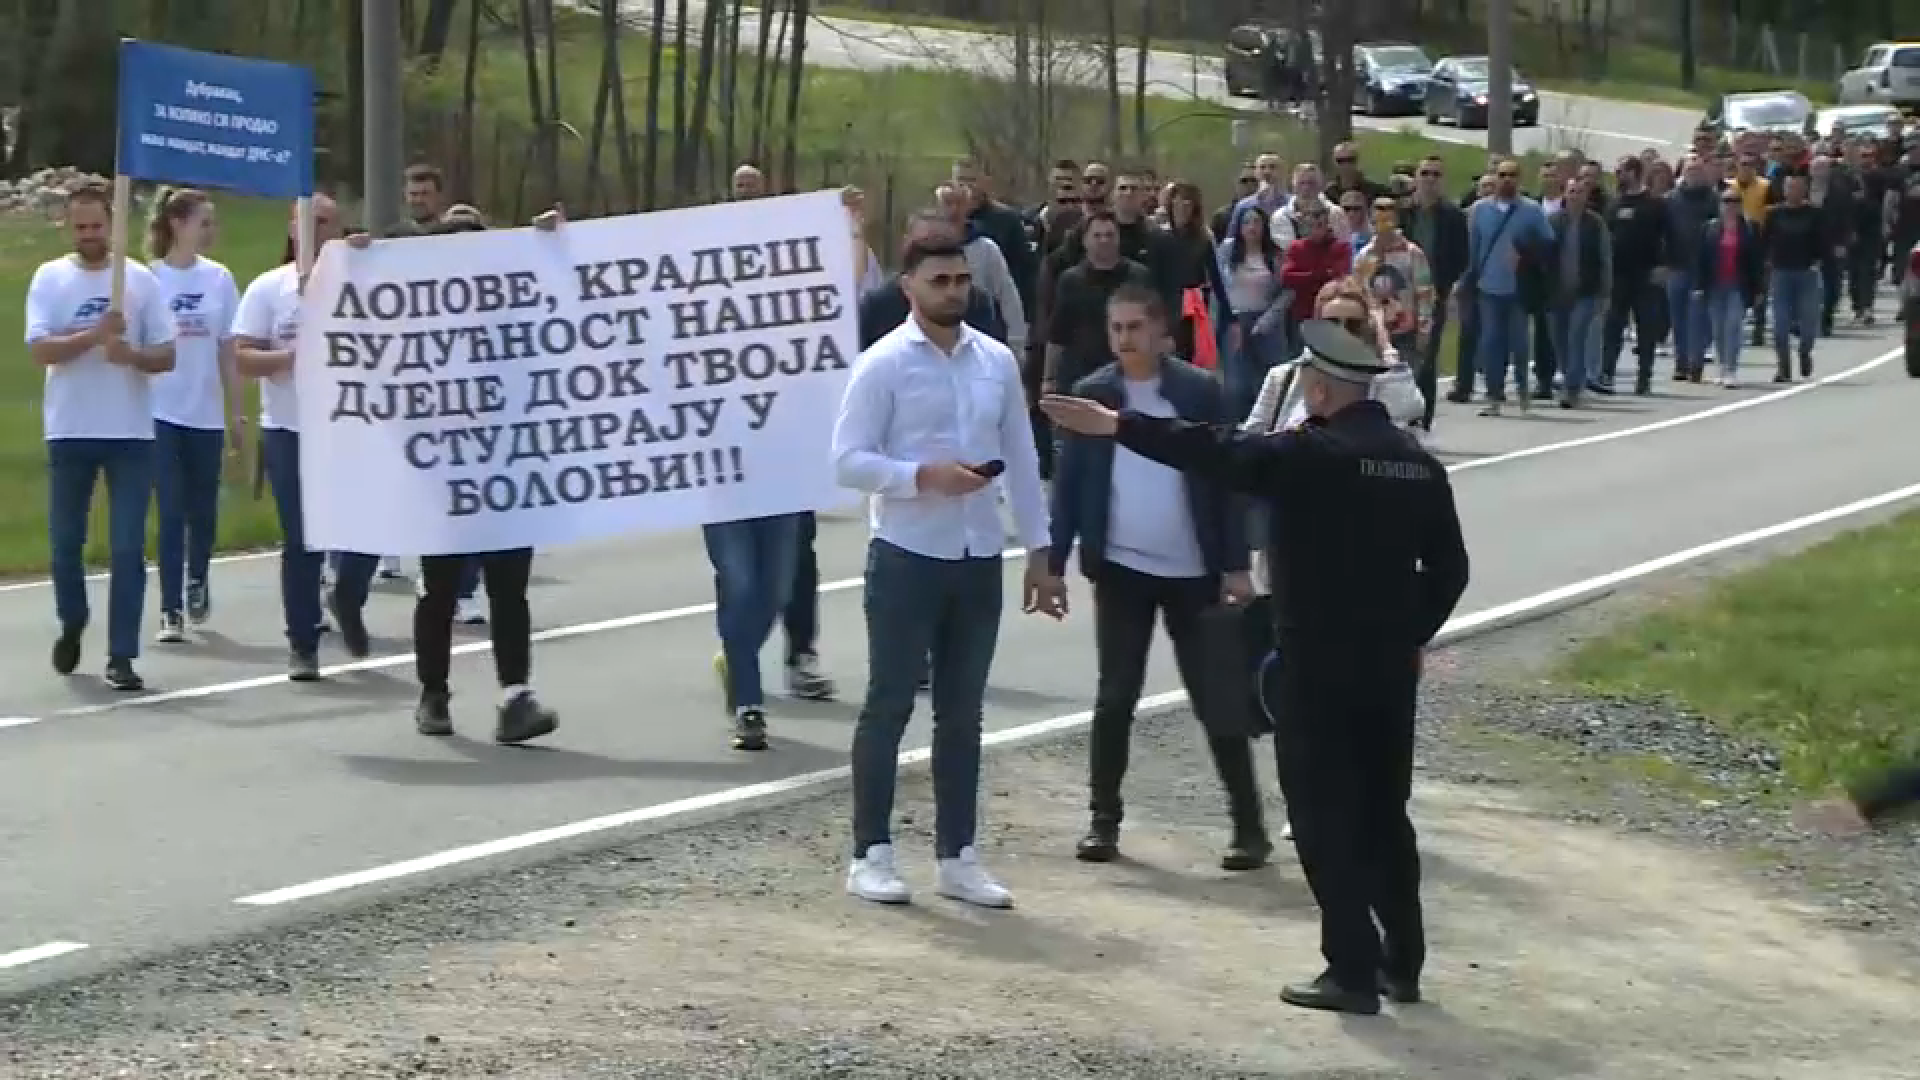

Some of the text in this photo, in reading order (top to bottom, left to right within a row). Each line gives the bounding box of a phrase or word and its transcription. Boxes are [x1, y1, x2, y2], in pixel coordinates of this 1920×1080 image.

[332, 235, 824, 321] ЛОПОВЕ, КРАДЕШ
[324, 284, 843, 376] БУДУЋНОСТ НАШЕ
[330, 334, 848, 424] ДЈЕЦЕ ДОК ТВОЈА
[404, 391, 778, 470] СТУДИРАЈУ У
[446, 446, 745, 517] БОЛОЊИ!!!
